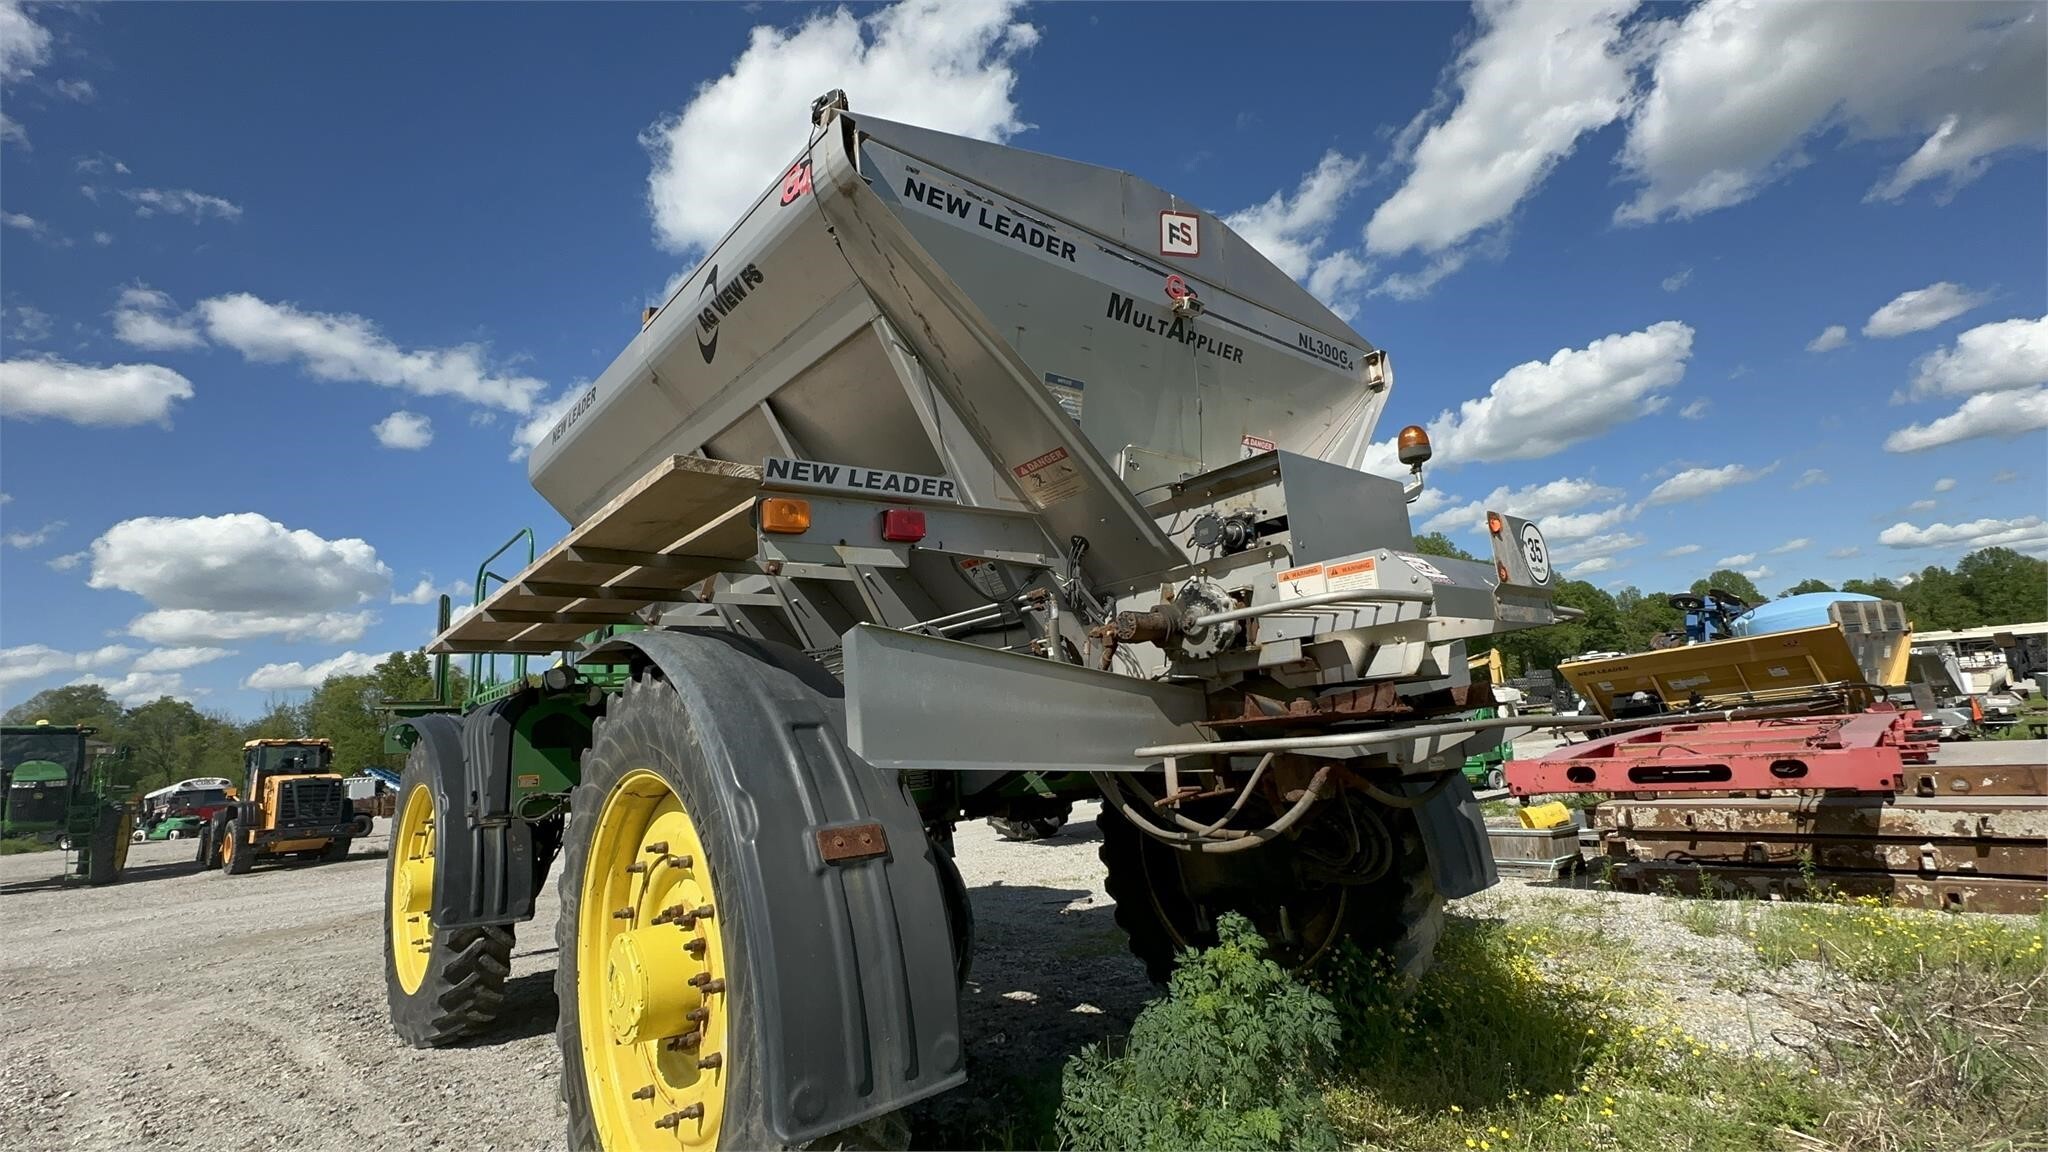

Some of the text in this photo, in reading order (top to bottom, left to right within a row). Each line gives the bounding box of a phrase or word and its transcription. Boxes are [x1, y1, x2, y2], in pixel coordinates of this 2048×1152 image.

[904, 177, 1077, 263] NEW LEADER
[1168, 222, 1192, 246] FS
[697, 263, 764, 334] AG VIEW FS
[551, 386, 597, 446] NEW LEADER
[1027, 450, 1064, 470] DANGER
[766, 458, 955, 498] NEW LEADER
[1527, 537, 1543, 563] 35
[1292, 567, 1318, 578] WARNING
[1342, 561, 1370, 573] WARNING
